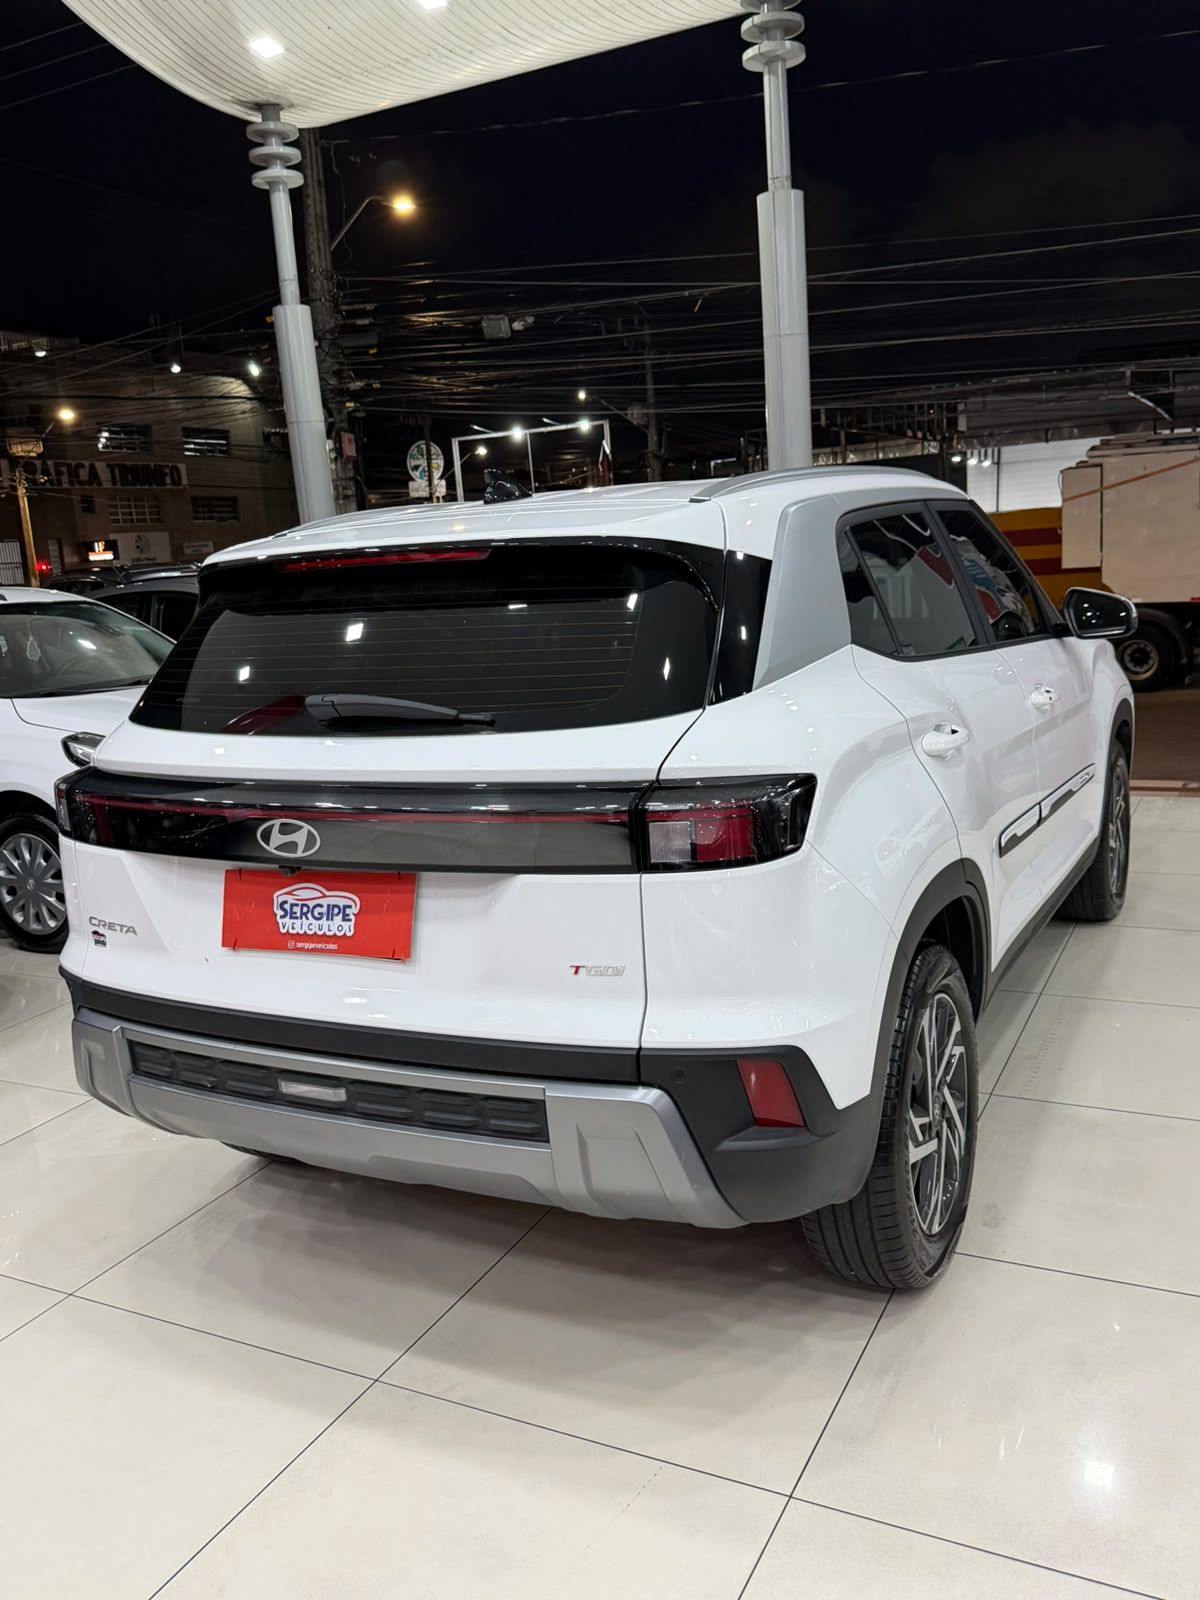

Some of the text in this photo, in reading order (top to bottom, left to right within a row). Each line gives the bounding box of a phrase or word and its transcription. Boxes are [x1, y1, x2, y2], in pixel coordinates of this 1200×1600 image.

[107, 463, 182, 487] TRIUNFO
[279, 900, 353, 922] SERGIPE
[89, 916, 138, 936] CRETA
